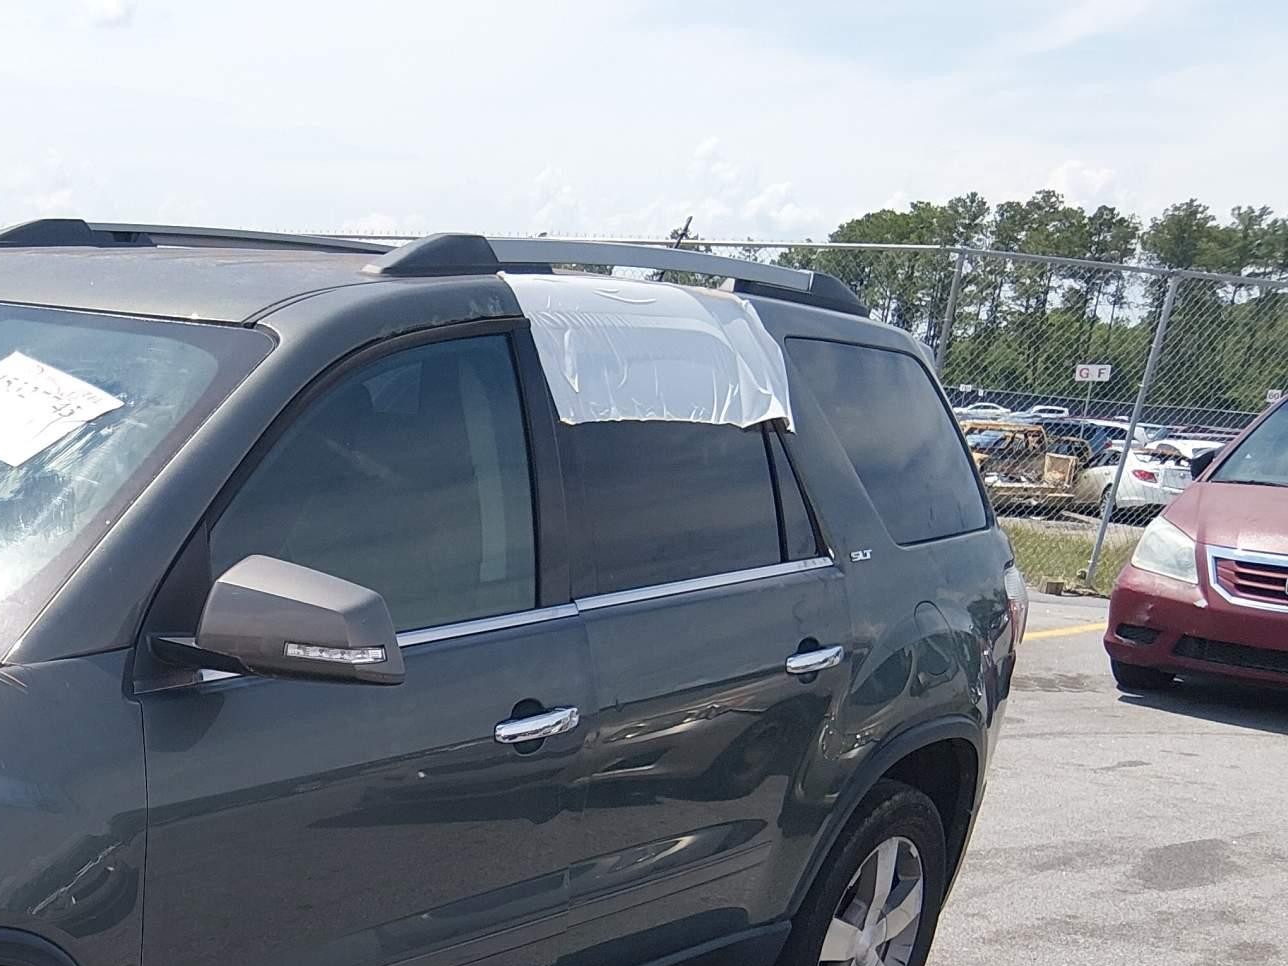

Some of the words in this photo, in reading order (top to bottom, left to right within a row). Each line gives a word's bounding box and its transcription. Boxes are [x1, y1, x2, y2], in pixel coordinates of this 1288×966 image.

[1079, 367, 1090, 379] G
[1097, 367, 1106, 378] F
[850, 549, 872, 562] SLT
